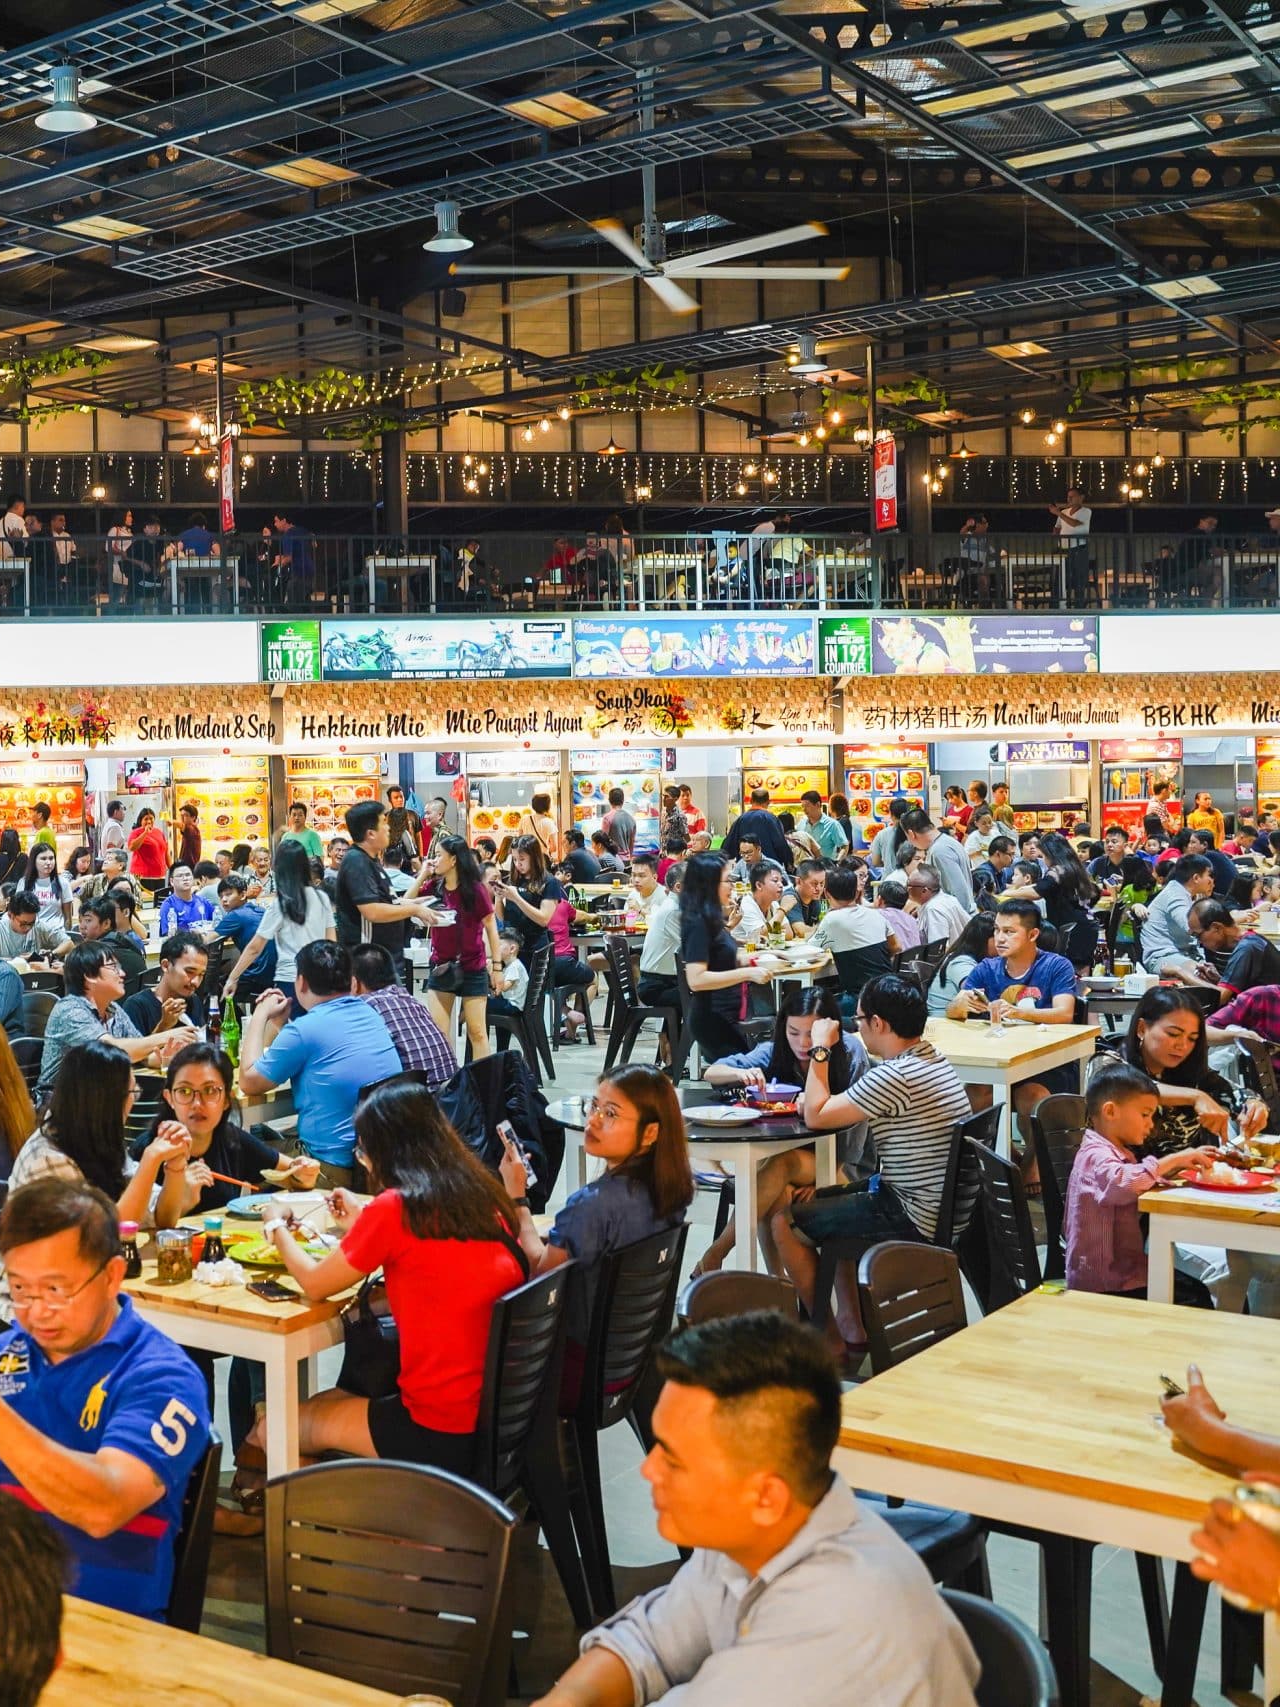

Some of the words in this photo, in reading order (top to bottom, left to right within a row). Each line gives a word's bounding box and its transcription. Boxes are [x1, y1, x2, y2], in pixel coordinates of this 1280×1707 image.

[405, 633, 433, 642] Ninja
[268, 650, 283, 669] IN
[288, 650, 313, 670] 192
[825, 644, 838, 663] IN
[842, 644, 866, 663] 192
[268, 669, 314, 682] COUNTRIES
[825, 662, 867, 675] COUNTRIES
[595, 689, 633, 714] Soup
[634, 687, 675, 709] Ikan
[445, 709, 483, 735] Mie
[483, 708, 539, 738] Pangsit
[544, 709, 584, 739] Ayam
[863, 705, 988, 731] 药材猪肚汤
[993, 702, 1028, 727] Nasi
[1028, 703, 1049, 725] Tim
[1050, 701, 1082, 727] Ayam
[1084, 702, 1120, 725] Jamur
[1140, 704, 1187, 728] BBK
[1190, 703, 1219, 727] HK
[137, 715, 172, 741] Soto
[175, 714, 231, 740] Medan
[233, 714, 245, 739] &
[247, 713, 276, 743] Sop
[300, 714, 383, 740] Hokkian
[386, 713, 427, 738] Mie
[782, 720, 808, 732] Yong
[812, 720, 837, 732] Tahu
[1011, 751, 1042, 760] AYAM
[1045, 750, 1086, 760] JAMUR
[1022, 743, 1050, 752] NASI
[1052, 743, 1074, 752] TIM
[291, 759, 334, 770] Hokkian
[338, 759, 358, 769] Mie
[149, 1396, 199, 1458] 5
